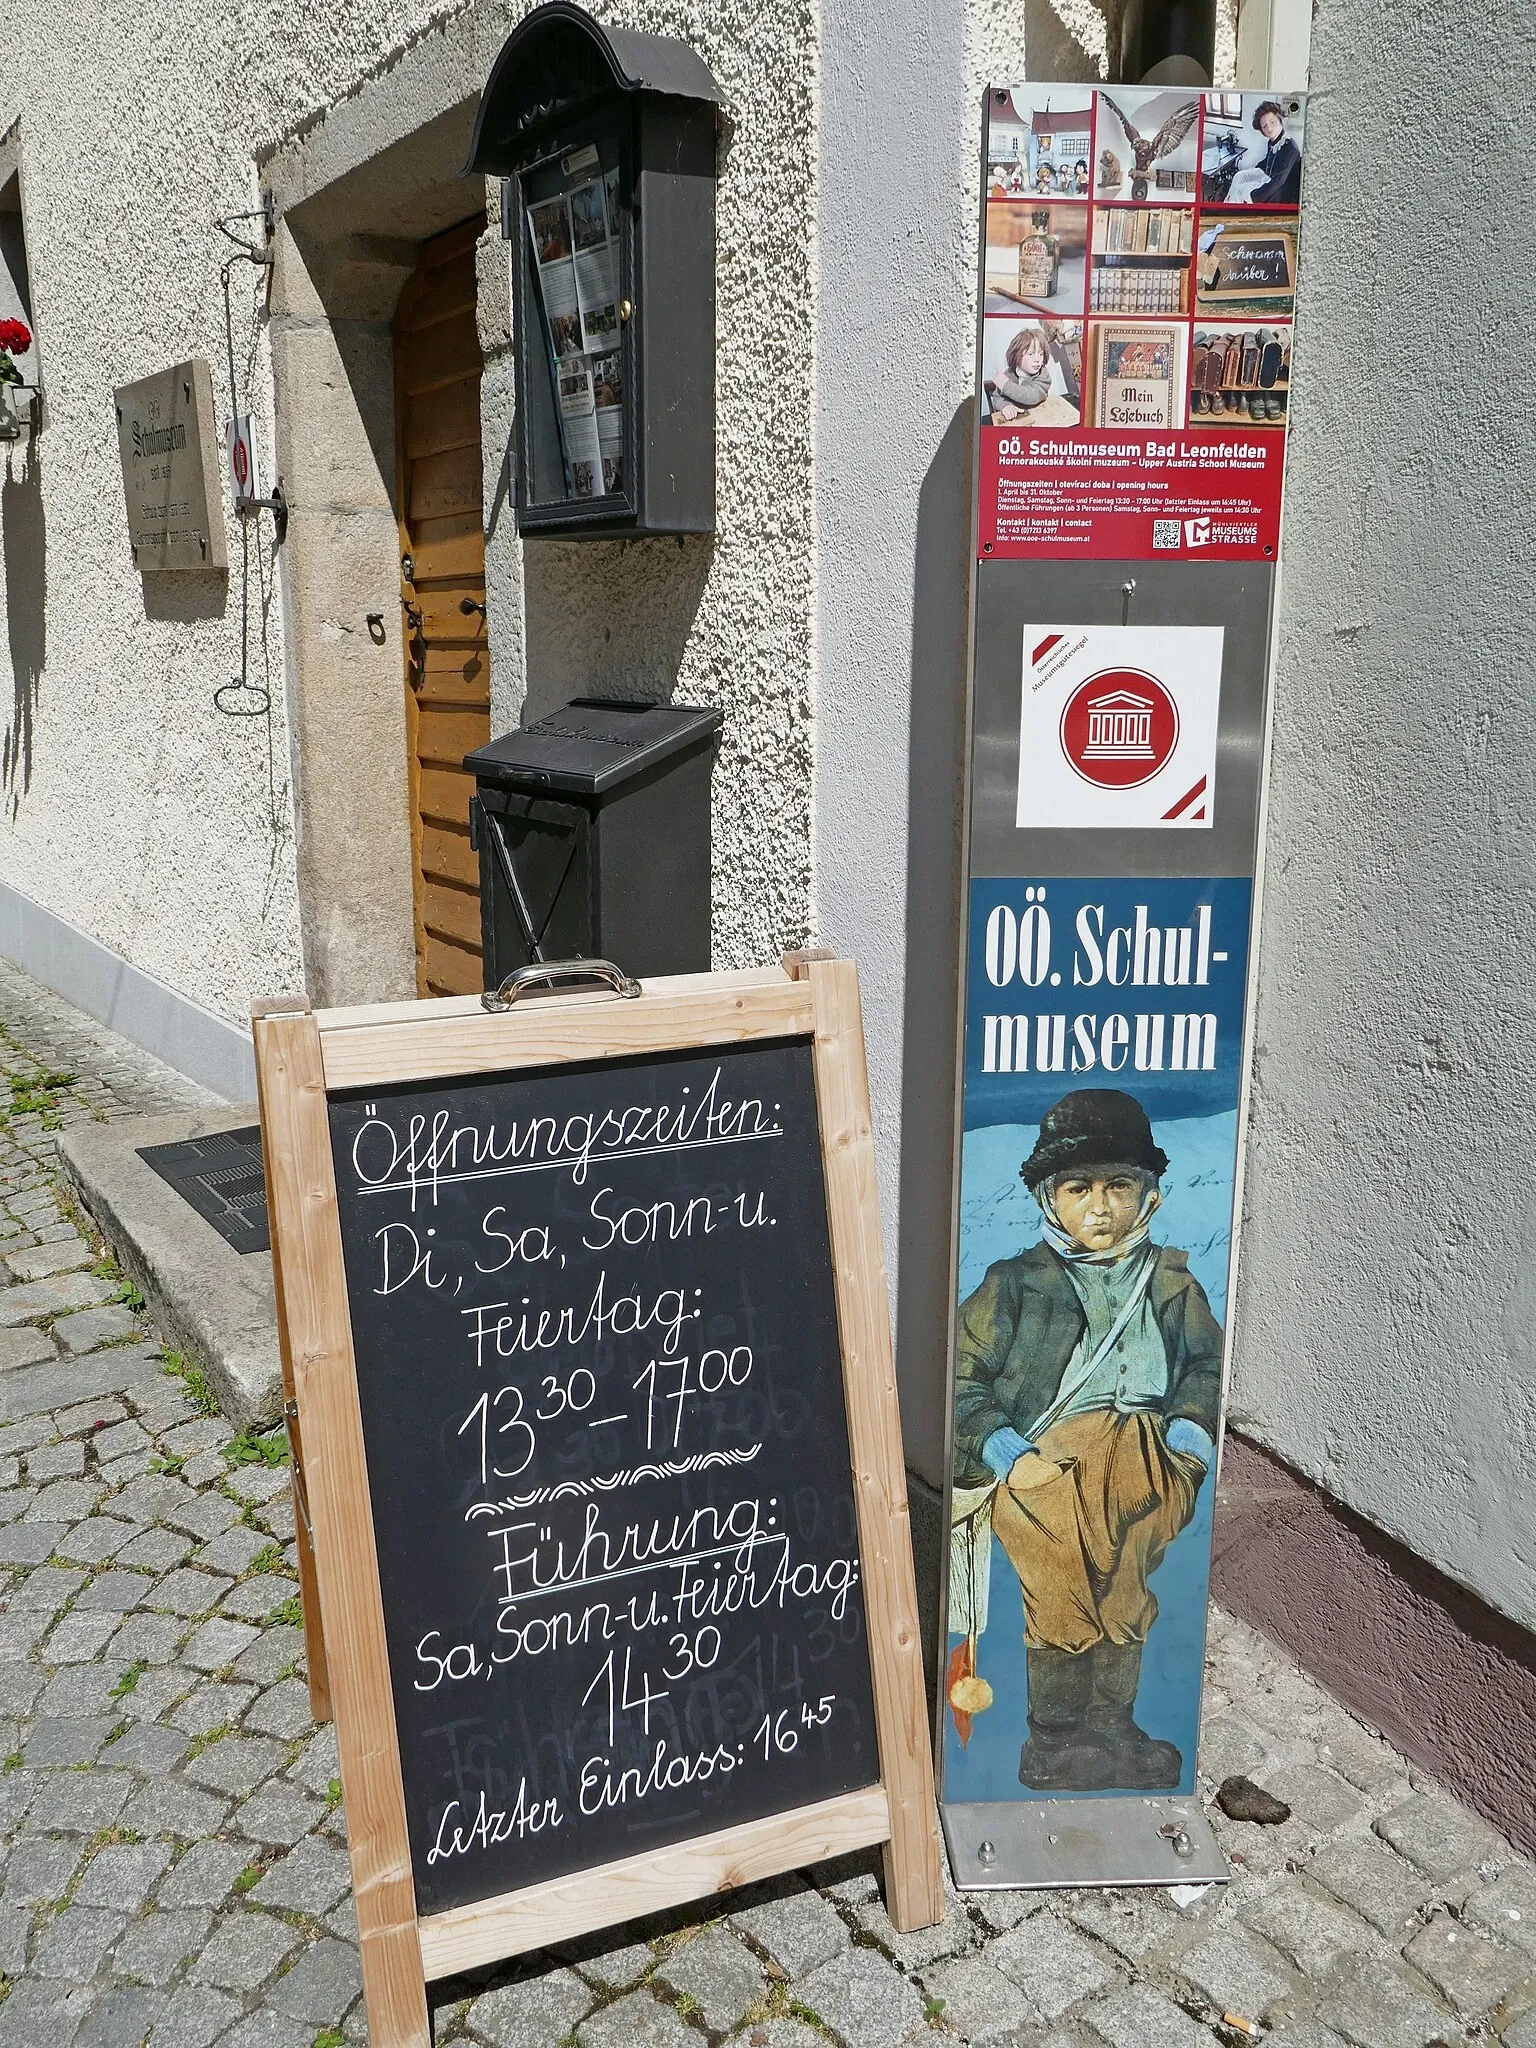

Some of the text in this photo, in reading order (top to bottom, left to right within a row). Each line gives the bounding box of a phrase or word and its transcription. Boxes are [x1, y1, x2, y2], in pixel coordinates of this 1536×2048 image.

[1222, 245, 1286, 261] Schwamm
[1121, 387, 1154, 403] Mein
[998, 436, 1267, 459] OÖ. Schulmuseum Bad Leonfelden
[998, 456, 1064, 466] Hornorakouské
[1093, 458, 1130, 467] muzeum
[1139, 458, 1164, 469] Upper
[1166, 459, 1197, 468] Austria
[1198, 459, 1228, 469] School
[1229, 460, 1265, 469] Museum
[997, 478, 1053, 489] Öffnungszeiten
[1092, 481, 1110, 489] doba
[1116, 482, 1146, 491] opening
[1147, 482, 1169, 490] hours
[1003, 489, 1019, 498] April
[1039, 489, 1064, 497] Oktober
[997, 504, 1030, 512] Öffentliche
[1031, 505, 1064, 513] Führungen
[1065, 505, 1075, 513] (ab
[1081, 505, 1113, 513] Personen)
[1175, 506, 1201, 515] Feiertag
[1201, 506, 1223, 515] jeweils
[1089, 498, 1115, 506] Feiertag
[1164, 498, 1187, 506] (letzter
[1237, 499, 1252, 507] Uhr)
[996, 518, 1026, 527] Kontakt
[1031, 518, 1060, 527] kontakt
[1064, 519, 1093, 527] contact
[1010, 535, 1091, 543] www.ooe-schulmuseum.at
[1211, 526, 1258, 536] MUSEUMS
[1210, 535, 1258, 545] STRASSE
[1031, 635, 1089, 693] Museumsgütesiegel
[985, 886, 1228, 987] OÖ. Schul-
[981, 1013, 1218, 1073] museum
[352, 1066, 784, 1212] Öffnungszeiten:
[373, 1221, 464, 1297] Di,
[474, 1205, 566, 1274] Sa,
[460, 1270, 703, 1367] Feiertag:
[486, 1496, 779, 1598] Führung:
[426, 1777, 565, 1866] Letzter
[578, 1738, 744, 1817] Einlass:
